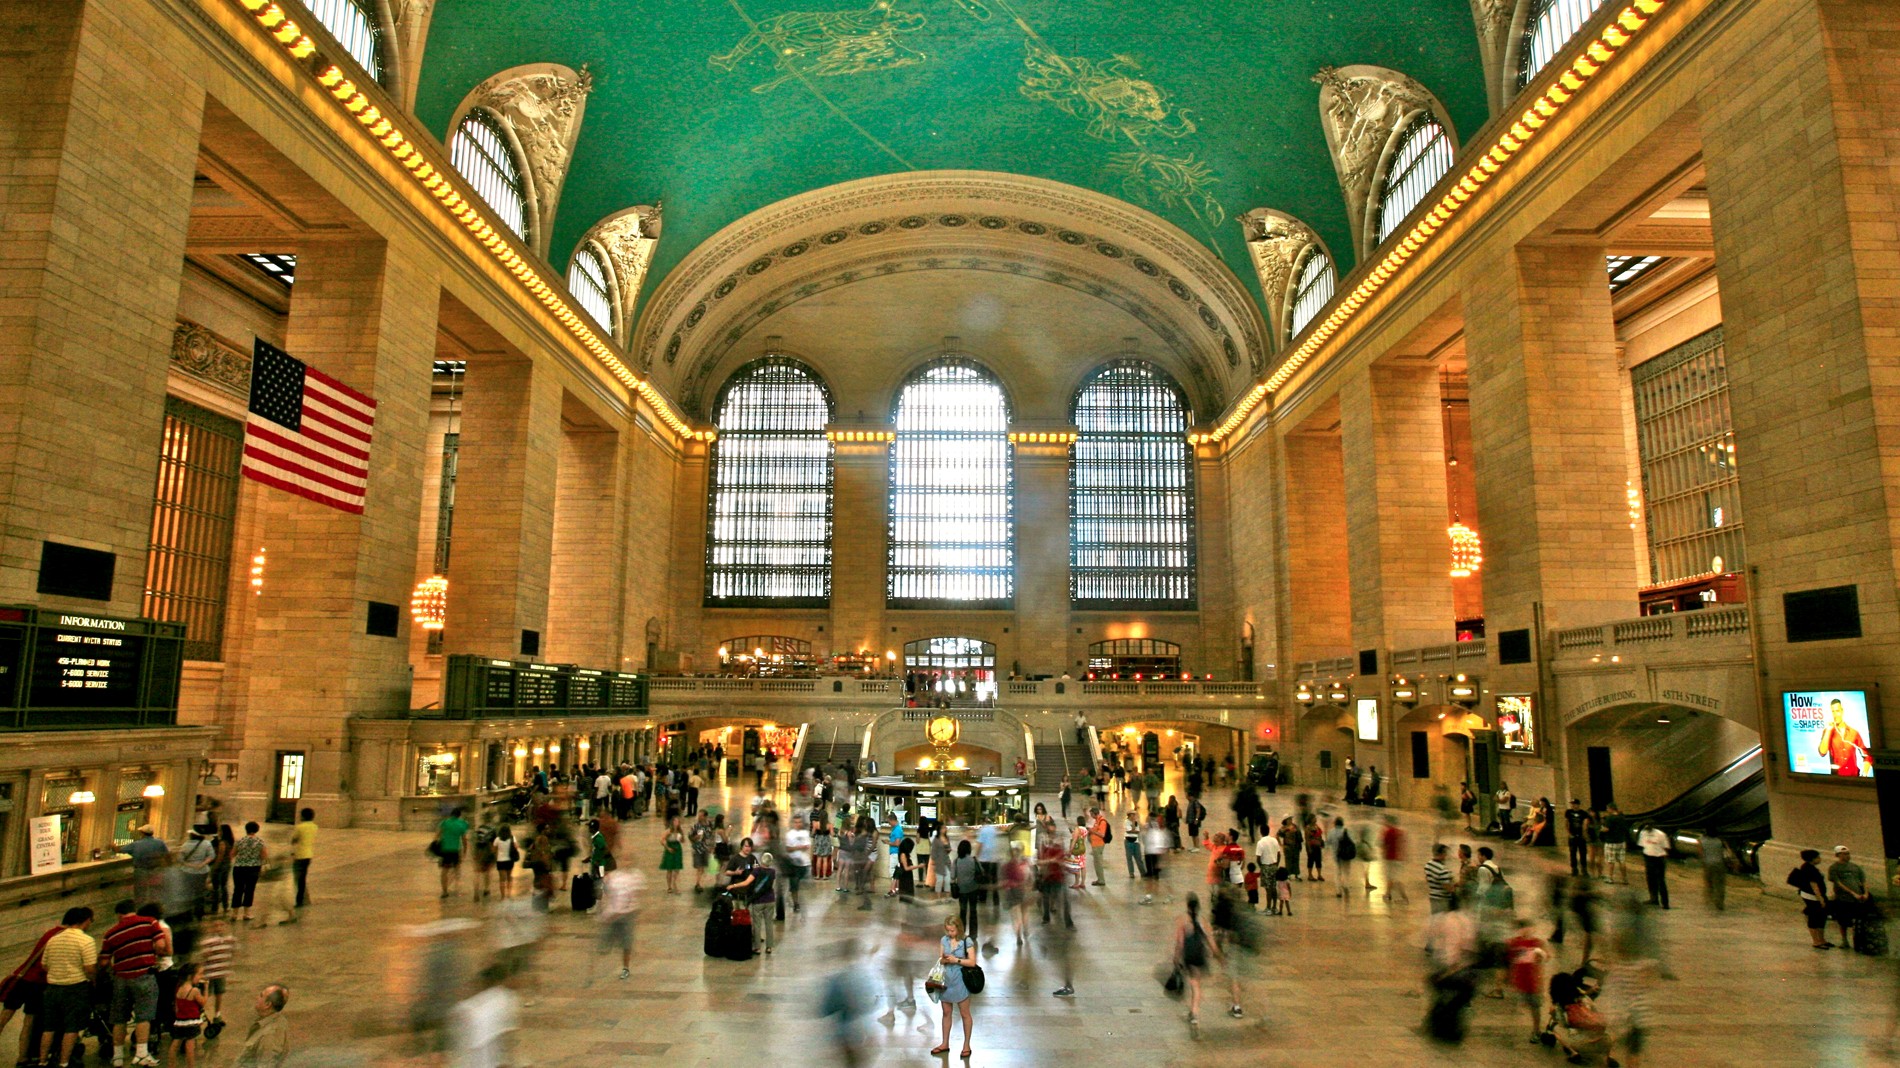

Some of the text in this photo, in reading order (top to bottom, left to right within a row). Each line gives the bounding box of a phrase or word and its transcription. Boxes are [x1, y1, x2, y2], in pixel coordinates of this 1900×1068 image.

[61, 615, 126, 630] INFORMATION
[57, 634, 82, 643] CURRENT
[102, 638, 122, 646] STATUS
[86, 670, 109, 678] SERVICE
[85, 680, 108, 688] SERVICE
[1603, 690, 1636, 704] BUILDING
[1662, 690, 1720, 709] 45TH STREET
[1790, 693, 1813, 707] How
[1791, 708, 1824, 720] STATES
[1799, 720, 1825, 729] SHAPES
